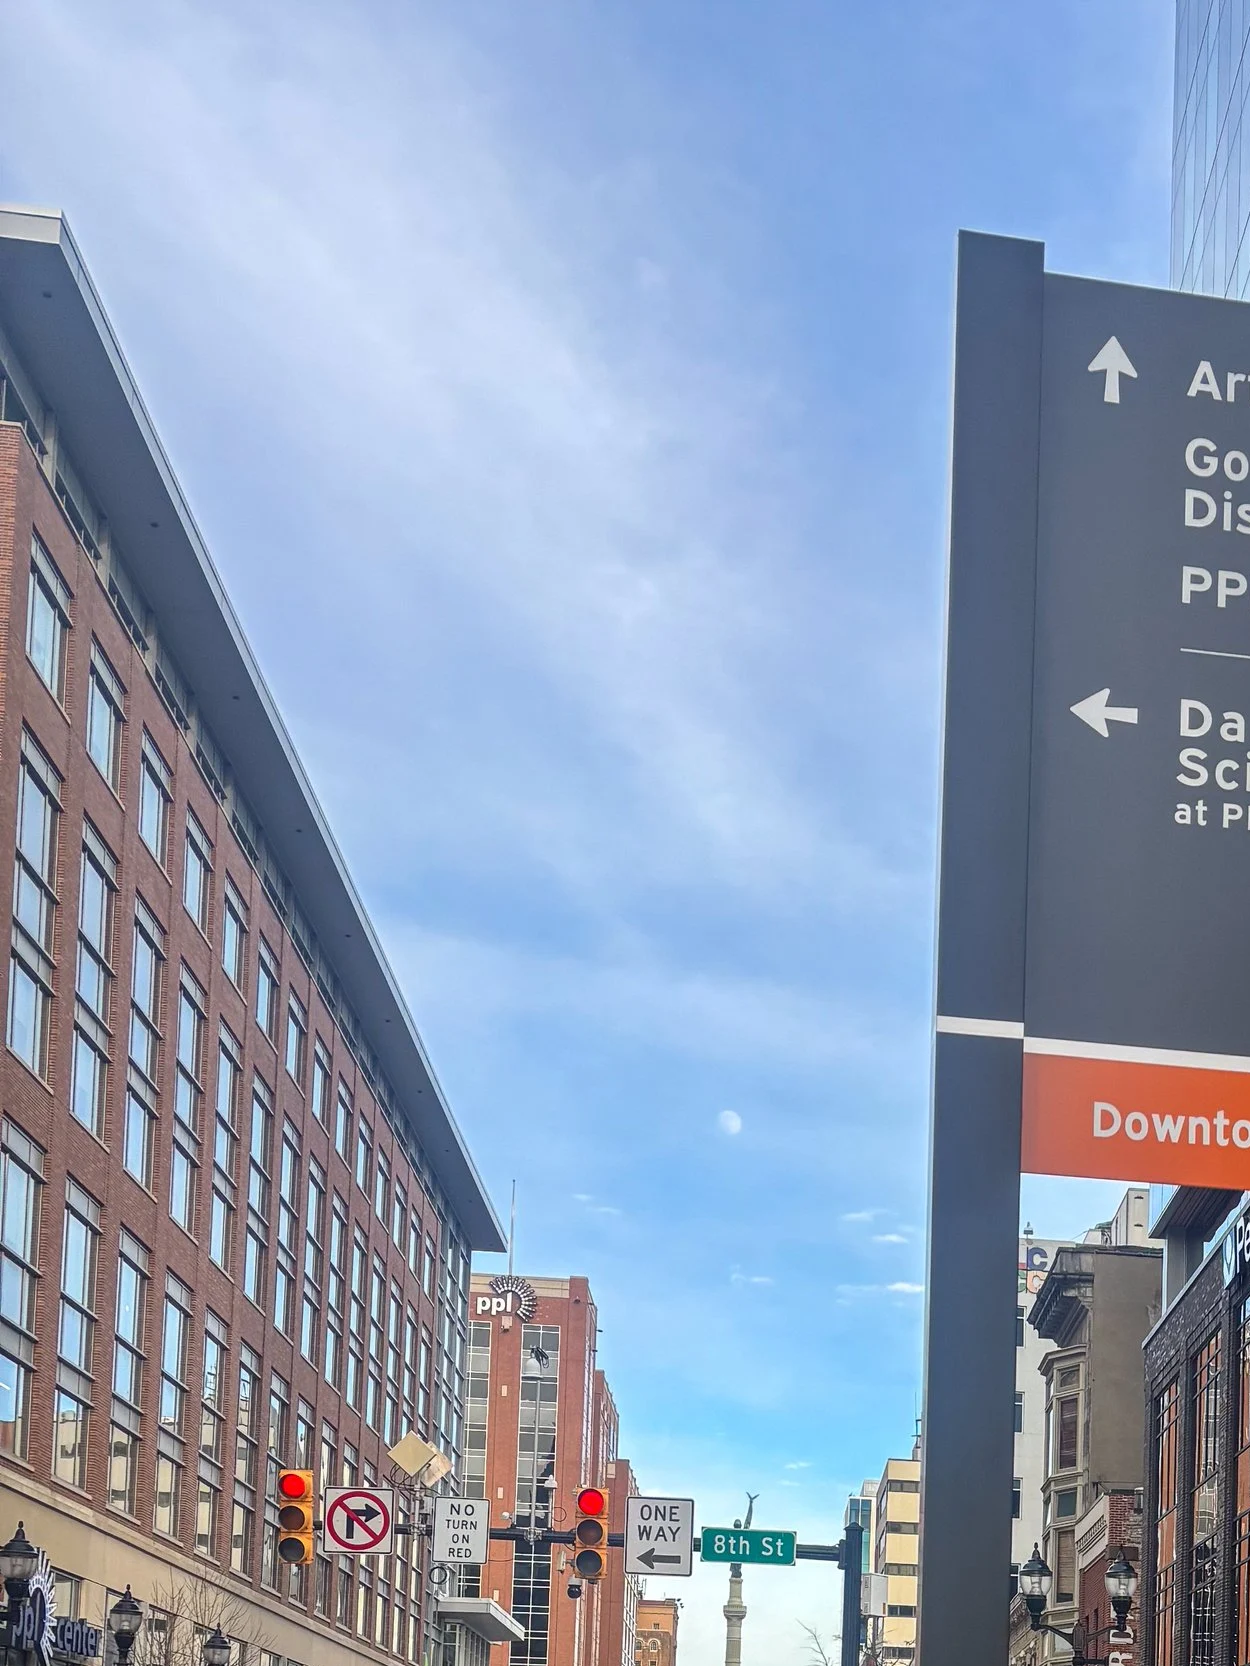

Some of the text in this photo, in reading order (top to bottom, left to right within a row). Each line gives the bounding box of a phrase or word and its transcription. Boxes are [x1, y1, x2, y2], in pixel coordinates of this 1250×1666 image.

[1179, 698, 1246, 742] Da
[1174, 800, 1208, 827] at
[476, 1291, 513, 1316] ppl
[449, 1503, 475, 1517] NO
[640, 1504, 681, 1522] ONE
[445, 1519, 478, 1531] TURN
[637, 1525, 681, 1542] WAY
[451, 1533, 470, 1544] ON
[714, 1534, 784, 1557] 8th St
[448, 1547, 472, 1559] RED
[57, 1618, 102, 1657] center
